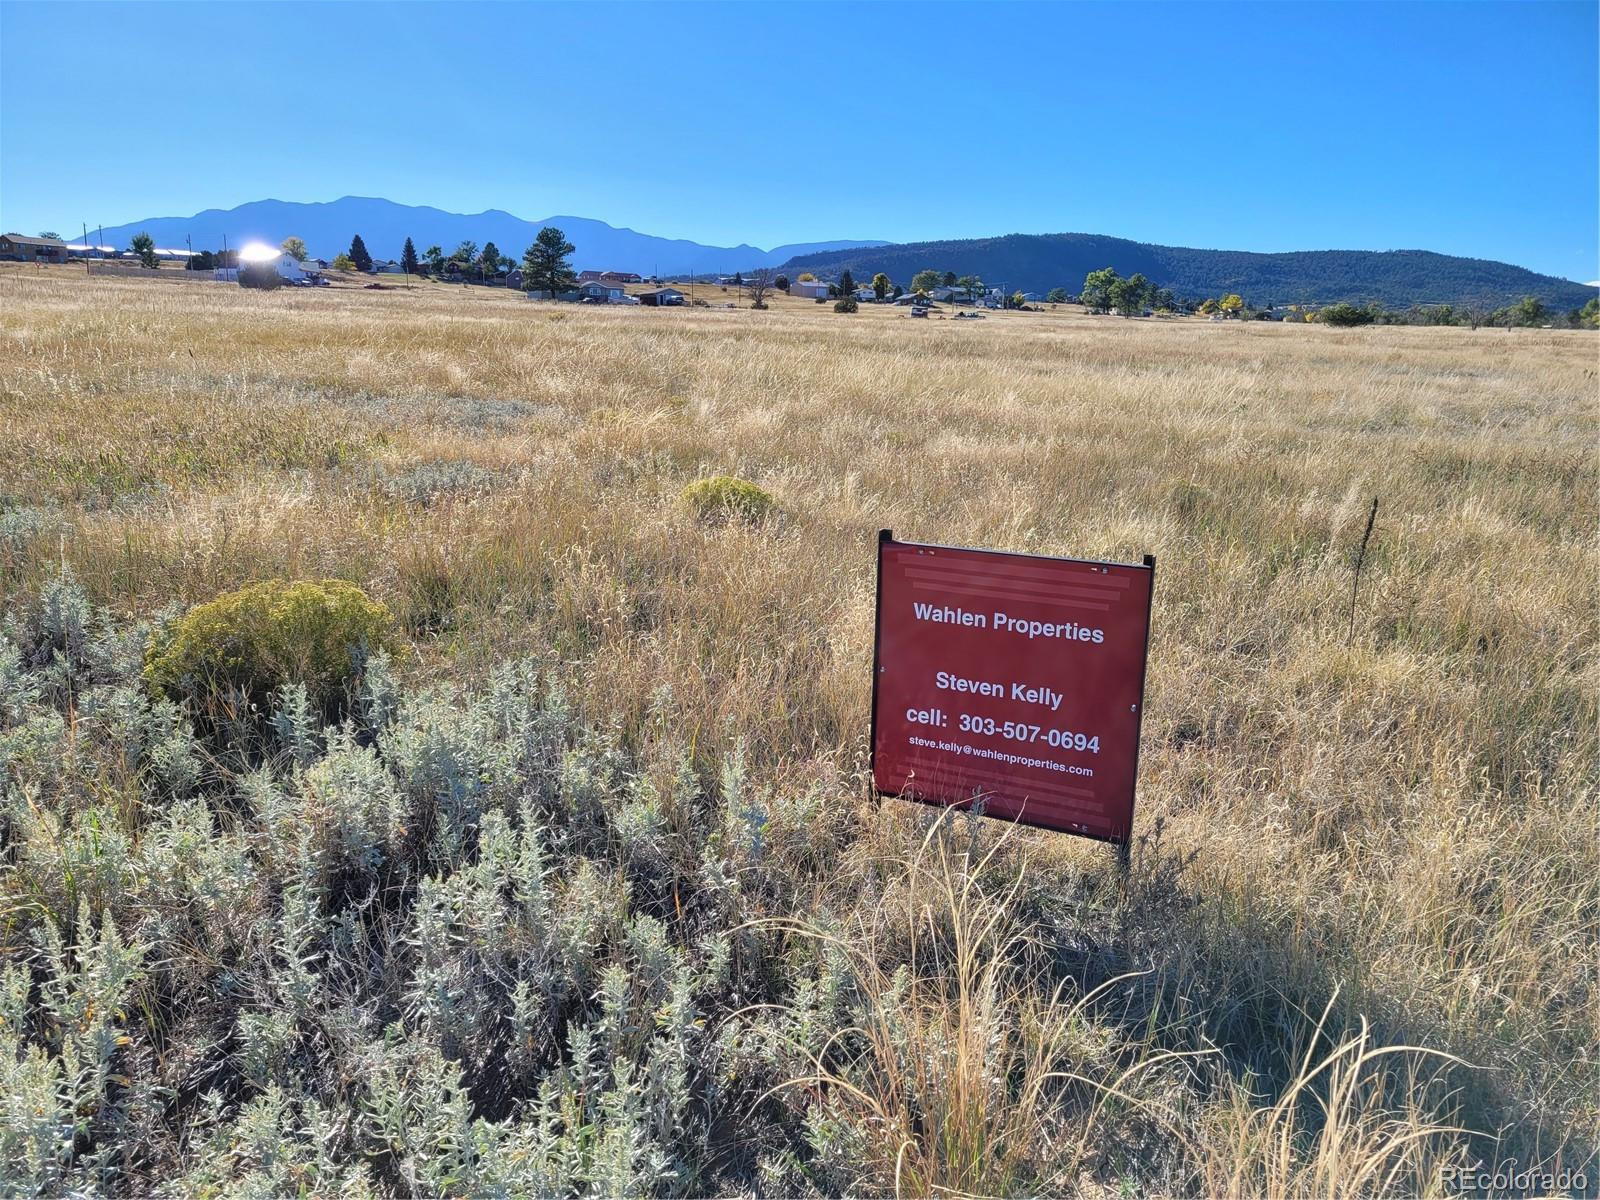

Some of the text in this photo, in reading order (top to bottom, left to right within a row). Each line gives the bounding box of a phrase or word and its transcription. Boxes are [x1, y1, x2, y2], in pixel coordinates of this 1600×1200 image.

[913, 602, 1105, 644] Wahlen Properties
[935, 671, 1064, 711] Steven Kelly
[906, 707, 1101, 754] cell: 303-507-0694
[908, 735, 1094, 777] steve.kelly@wahlenproperties.com
